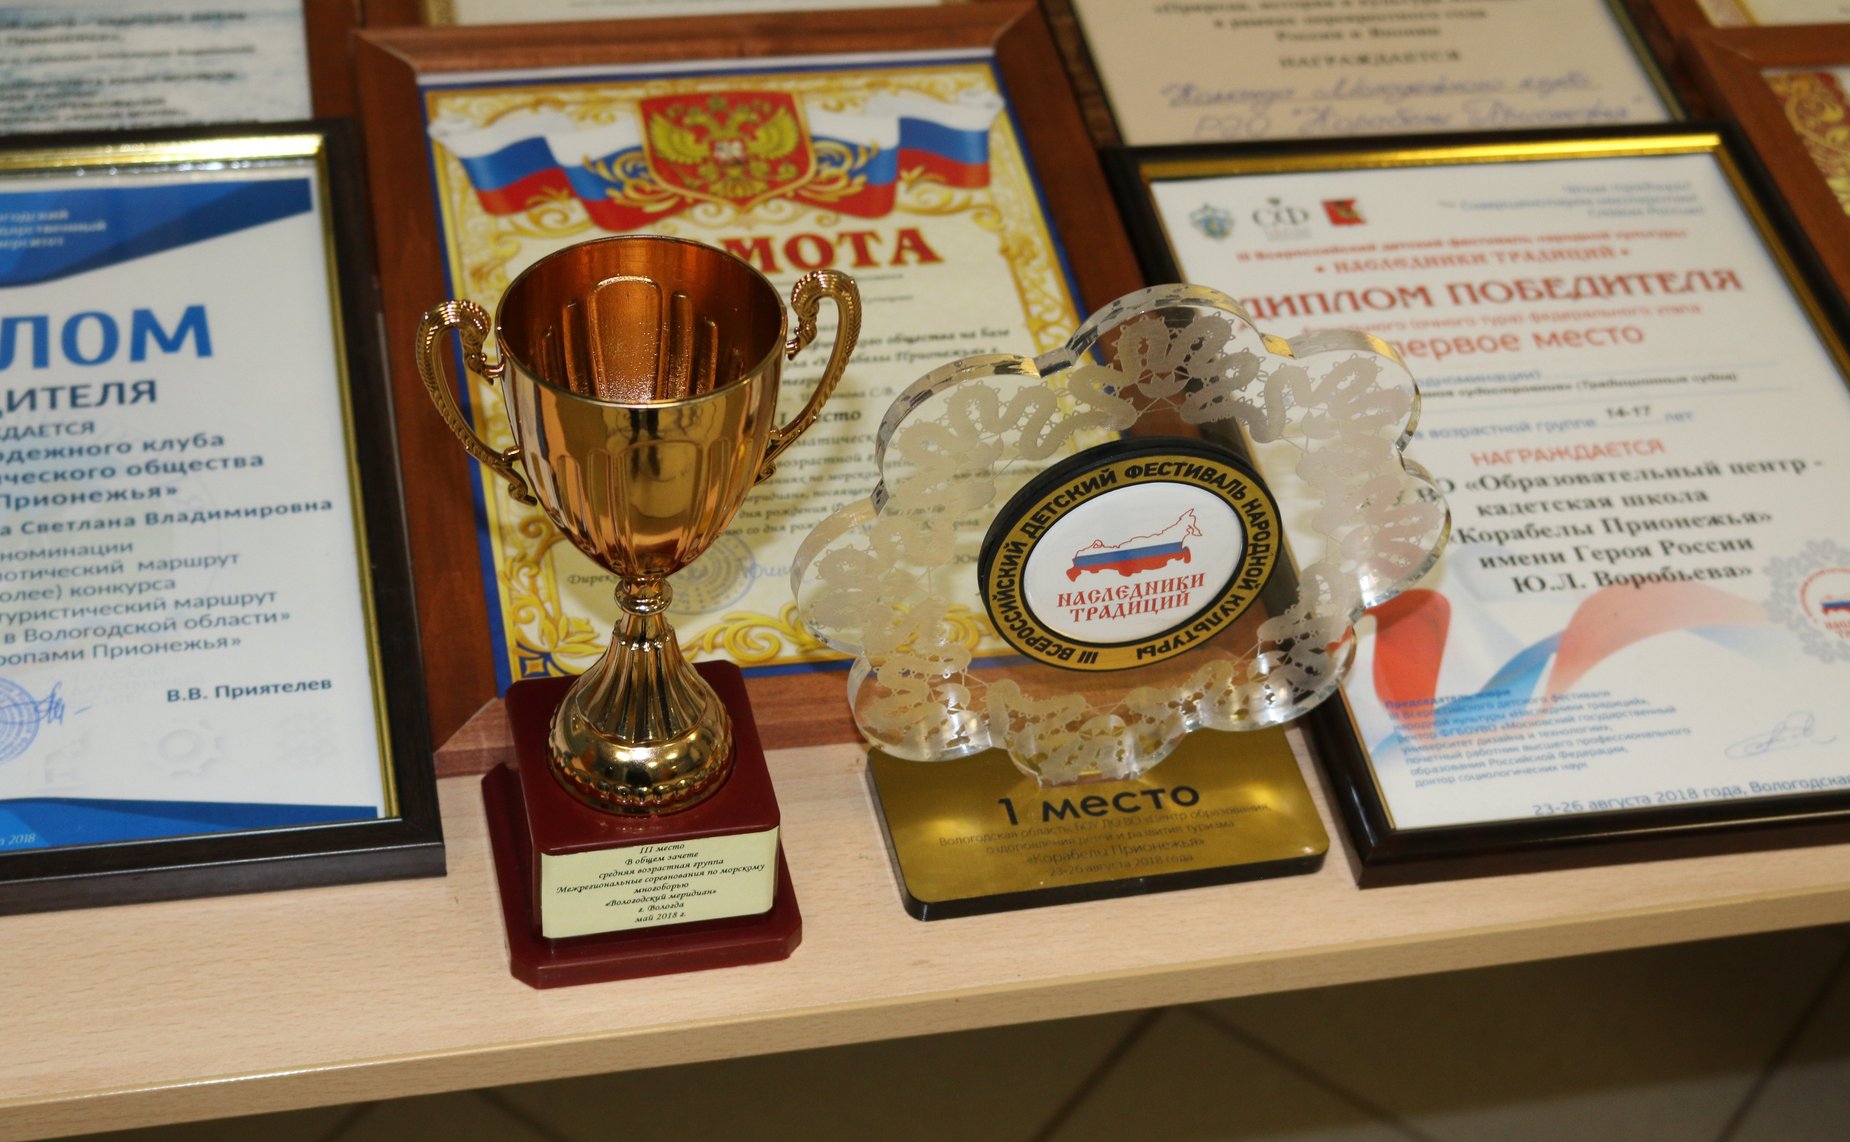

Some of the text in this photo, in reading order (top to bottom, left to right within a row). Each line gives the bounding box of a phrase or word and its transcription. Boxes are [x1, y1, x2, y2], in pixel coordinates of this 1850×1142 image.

[1445, 267, 1743, 304] ПОБЕДИТЕЛЯ
[1531, 325, 1646, 350] место
[0, 378, 158, 418] ИТЕЛЯ
[1605, 404, 1652, 420] 14-17
[143, 431, 225, 456] клуба
[1470, 437, 1667, 467] НАГРАЖДАЕТСЯ
[0, 453, 265, 485] ческого общества
[1123, 460, 1249, 502] ФЕСТИВАЛЬ
[1465, 458, 1721, 493] «Образовательный
[1729, 455, 1807, 478] центр
[20, 515, 137, 536] Светлана
[144, 498, 334, 528] Владимировна
[1021, 468, 1118, 541] ДЕТСКИЙ
[1476, 487, 1710, 518] кадетская школа
[1599, 509, 1773, 538] Прионежья»
[0, 540, 134, 564] номинации
[1240, 497, 1272, 594] НАРОДНОЙ
[1478, 536, 1755, 570] имени Героя России
[138, 551, 240, 575] маршрут
[1596, 562, 1753, 590] Воробьева»
[70, 577, 177, 600] конкурса
[174, 589, 278, 612] маршрут
[991, 539, 1077, 662] ВСЕРОССИЙСКИЙ
[1056, 572, 1207, 609] НАСЛЕДНИКИ
[1069, 592, 1192, 624] ТРАДИЦИЙ
[4, 609, 292, 645] в Вологодской области»
[1135, 591, 1247, 662] КУЛЬТУРЫ
[93, 634, 243, 661] Прионежья»
[214, 677, 333, 700] Приятелев
[998, 785, 1199, 826] 1 место
[1533, 800, 1584, 817] 23-26
[1588, 793, 1653, 814] августа
[1656, 786, 1700, 802] 2018
[624, 851, 699, 866] В общем зачете
[655, 842, 686, 854] место
[555, 863, 766, 895] Межрегиональные соревнования по морскому
[598, 858, 725, 881] средняя возрастная группа
[604, 887, 718, 909] «Вологодский меридиан»
[633, 880, 690, 895] многоборью
[633, 914, 655, 924] май
[656, 911, 678, 922] 2018
[646, 900, 686, 914] Вологда
